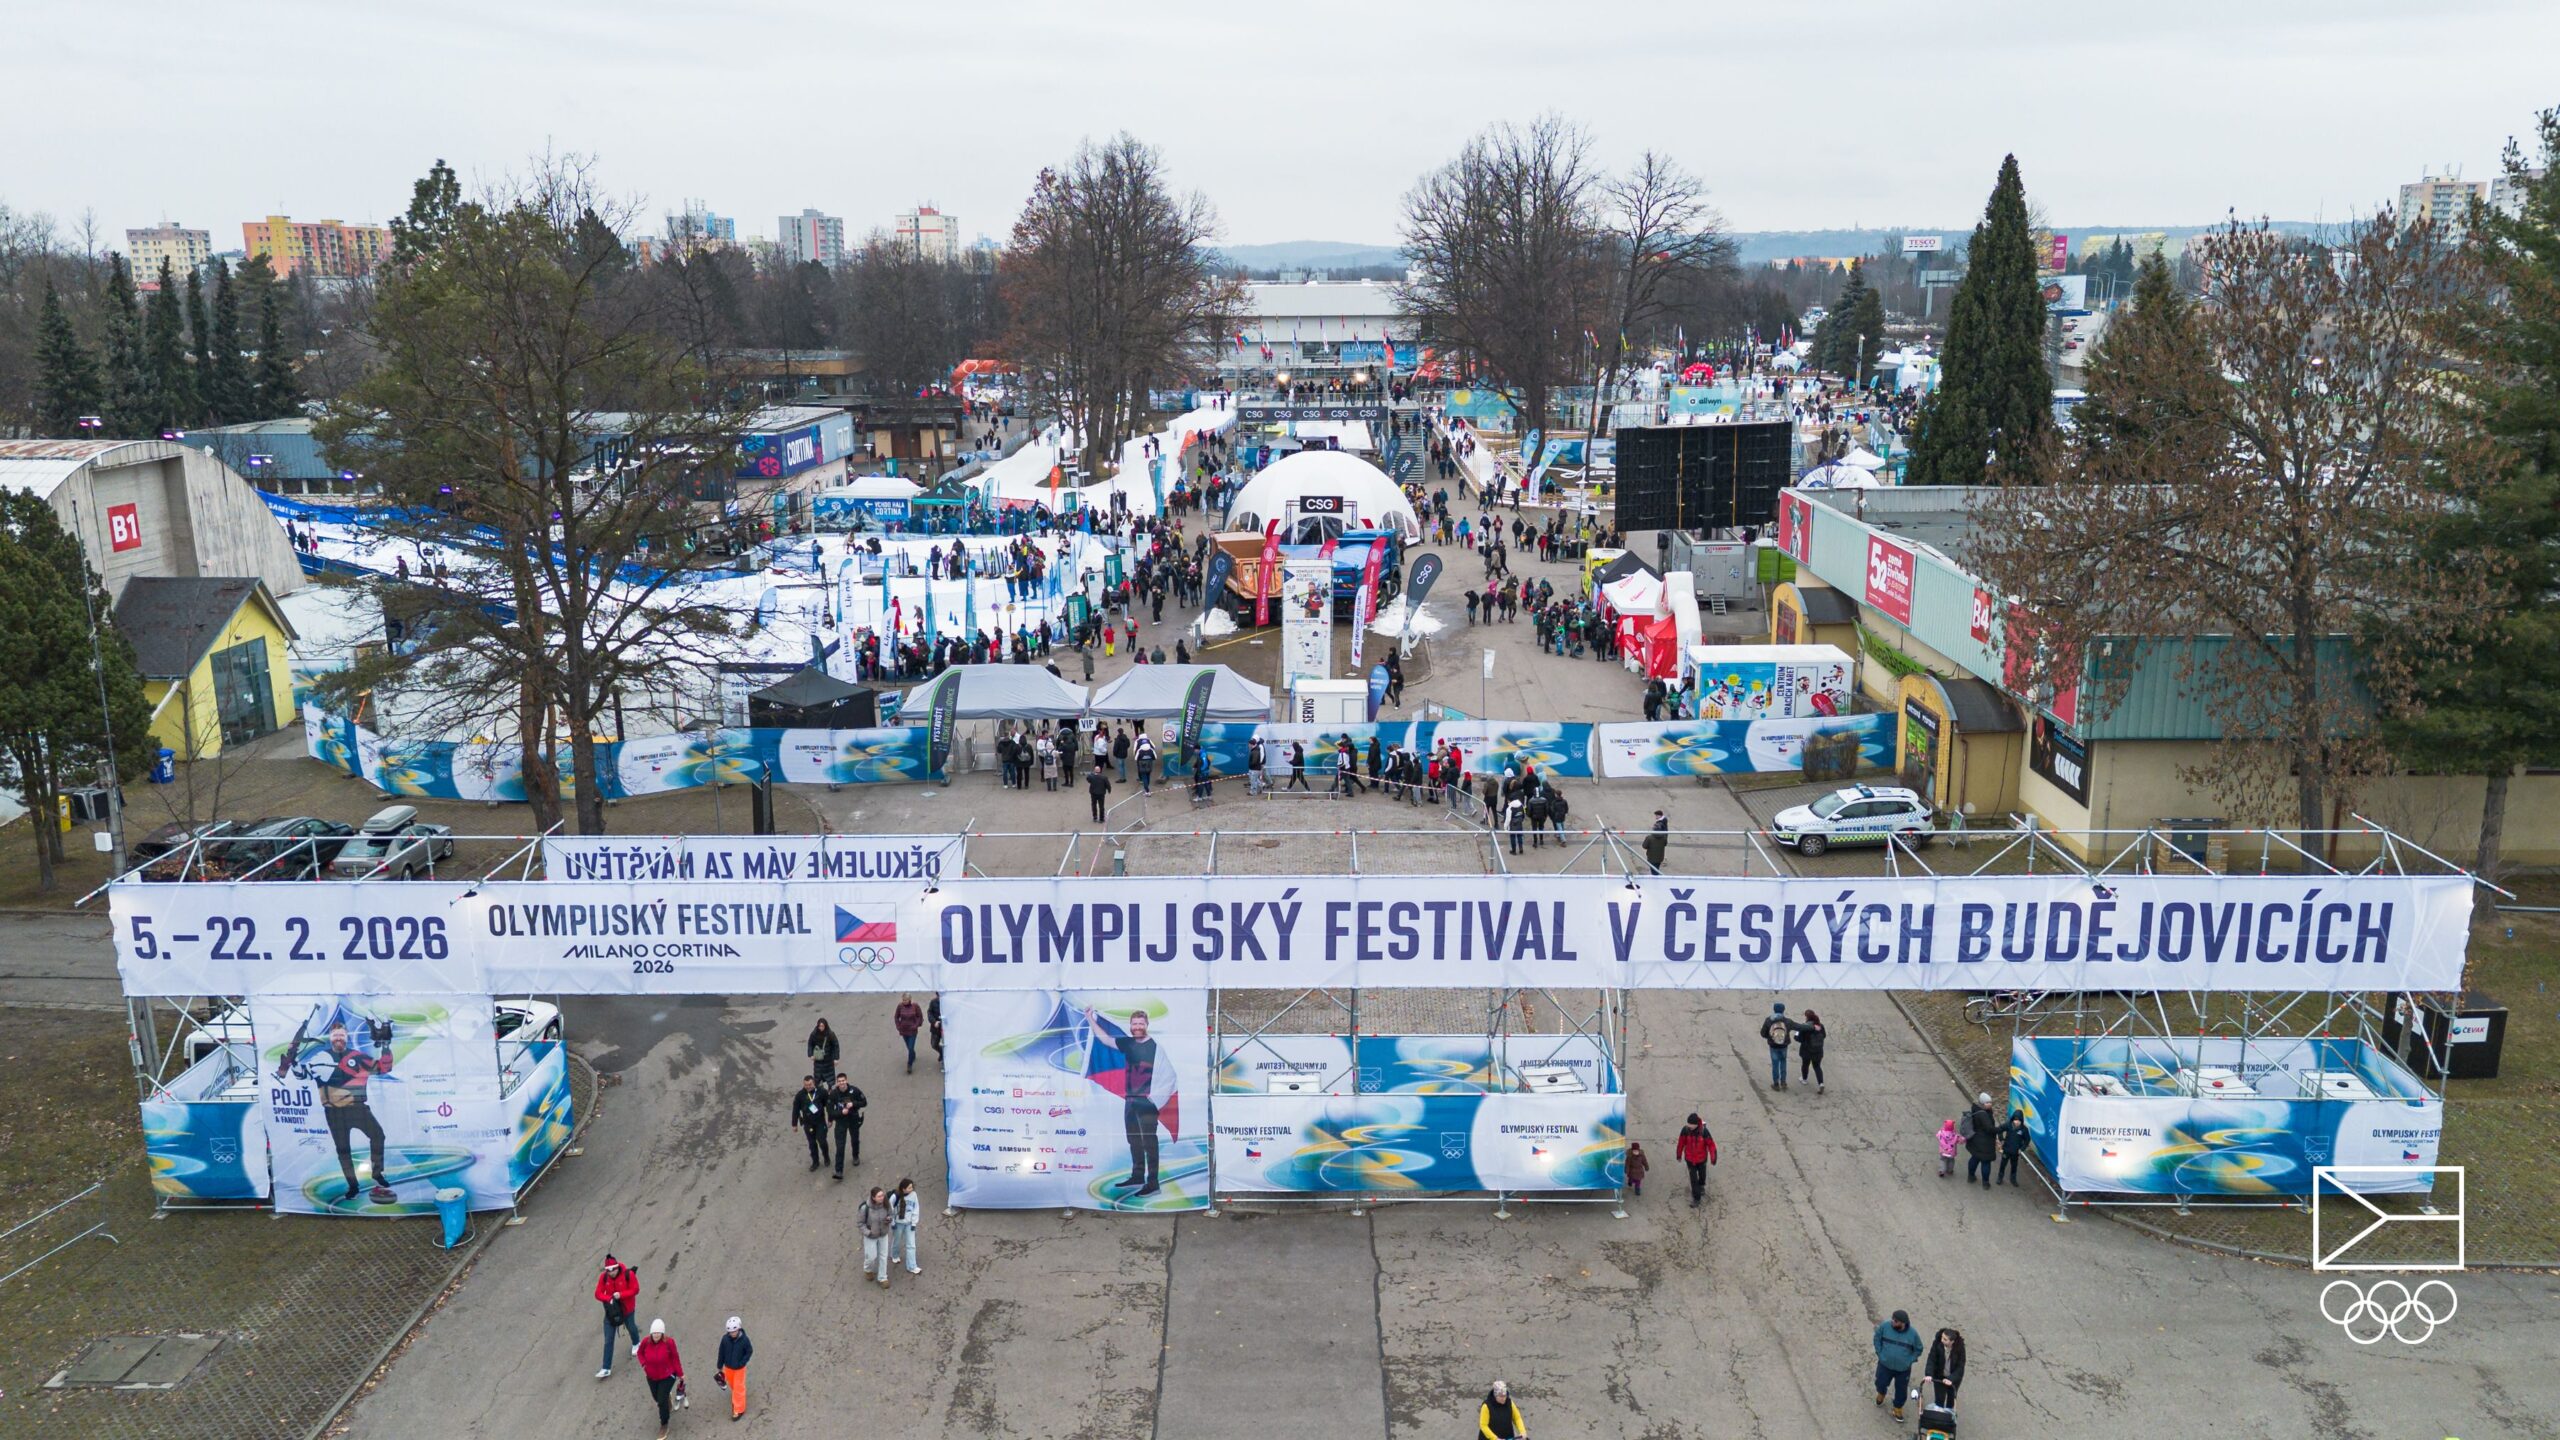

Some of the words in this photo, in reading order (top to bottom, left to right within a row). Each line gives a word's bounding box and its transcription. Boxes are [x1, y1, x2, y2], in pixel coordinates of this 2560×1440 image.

[1698, 397, 1722, 406] allwyn
[1245, 410, 1263, 418] CSG
[1274, 410, 1292, 418] CSG
[1302, 410, 1320, 418] CSG
[1359, 409, 1377, 417] CSG
[786, 435, 814, 466] CORTINA
[1306, 498, 1334, 510] CSG
[113, 512, 139, 544] B1
[1416, 563, 1433, 585] CSG
[1870, 541, 1888, 593] 52
[1972, 598, 1989, 630] B4
[1777, 666, 1786, 697] CENTRUM
[1786, 666, 1794, 689] KARET
[1303, 698, 1315, 723] SERVIS
[1081, 719, 1094, 730] VIP
[488, 899, 666, 937] OLYMPIJSKÝ
[678, 902, 812, 936] FESTIVAL
[940, 888, 1302, 964] OLYMPIJSKÝ
[1325, 901, 1577, 961] FESTIVAL
[1607, 901, 1642, 962] V
[1663, 888, 1935, 964] ČESKÝCH
[1957, 886, 2394, 964] BUDĚJOVICÍCH
[285, 916, 326, 961] 2.
[339, 916, 449, 961] 2026
[562, 944, 650, 960] MILANO
[653, 943, 742, 958] CORTINA
[632, 959, 675, 974] 2026
[2462, 1026, 2486, 1034] ČEVAK
[271, 1086, 313, 1108] POJĎ
[981, 1088, 1005, 1096] allwyn
[273, 1106, 309, 1117] SPORTOVAT
[275, 1116, 280, 1124] A
[281, 1114, 305, 1125] FANDIT!
[1216, 1125, 1257, 1136] OLYMPIJSKÝ
[1260, 1126, 1292, 1135] FESTIVAL
[1501, 1123, 1545, 1134] OLYMPIJSKÝ
[1547, 1124, 1579, 1134] FESTIVAL
[2070, 1125, 2117, 1136] OLYMPIJSKÝ
[2118, 1127, 2152, 1137] FESTIVAL
[2372, 1128, 2420, 1139] OLYMPIJSKÝ
[973, 1143, 991, 1152] VISA
